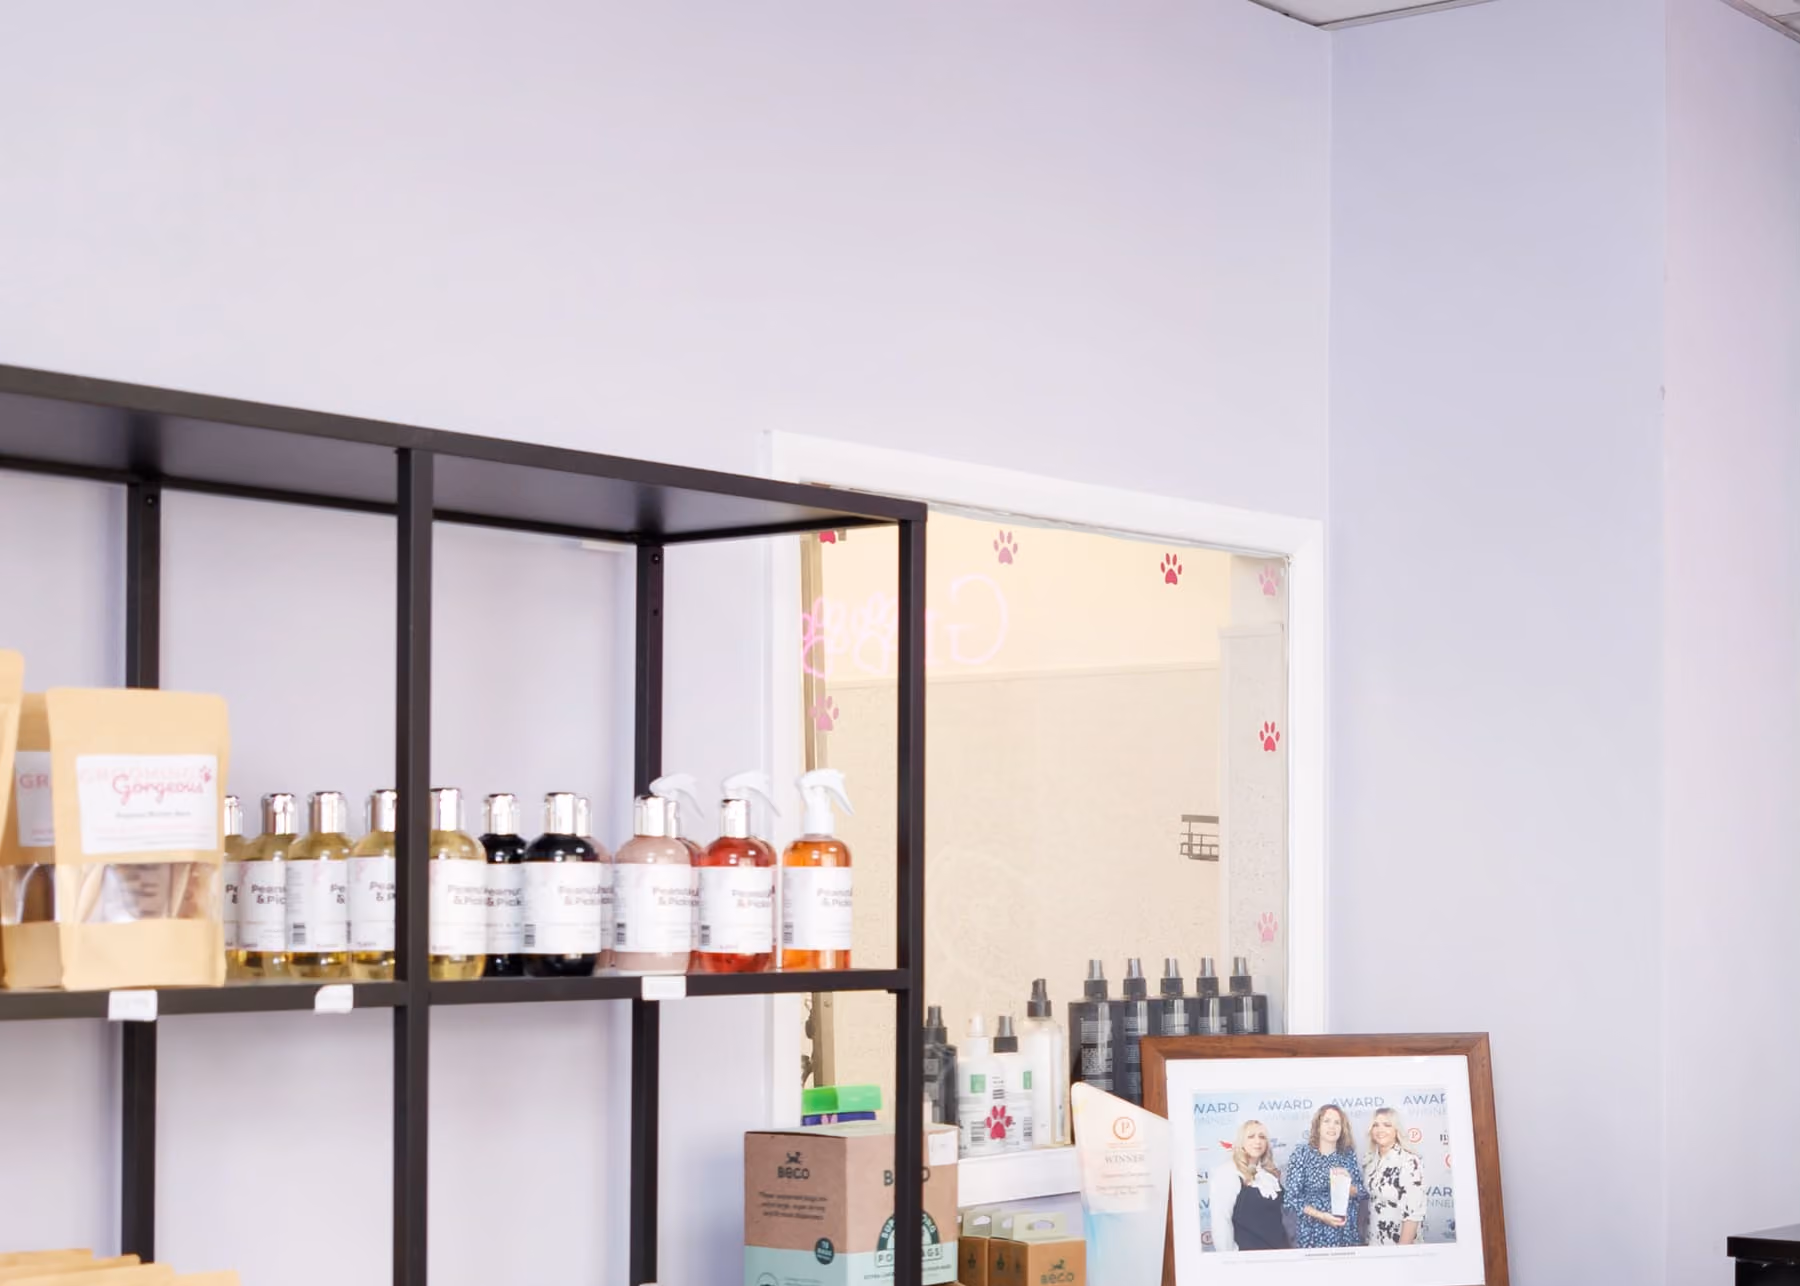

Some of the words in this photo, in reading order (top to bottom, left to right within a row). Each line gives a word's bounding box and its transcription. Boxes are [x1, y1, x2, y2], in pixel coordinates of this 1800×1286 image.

[1258, 1098, 1313, 1112] AWARD
[1331, 1096, 1385, 1108] AWARD
[1104, 1154, 1145, 1164] WINNER
